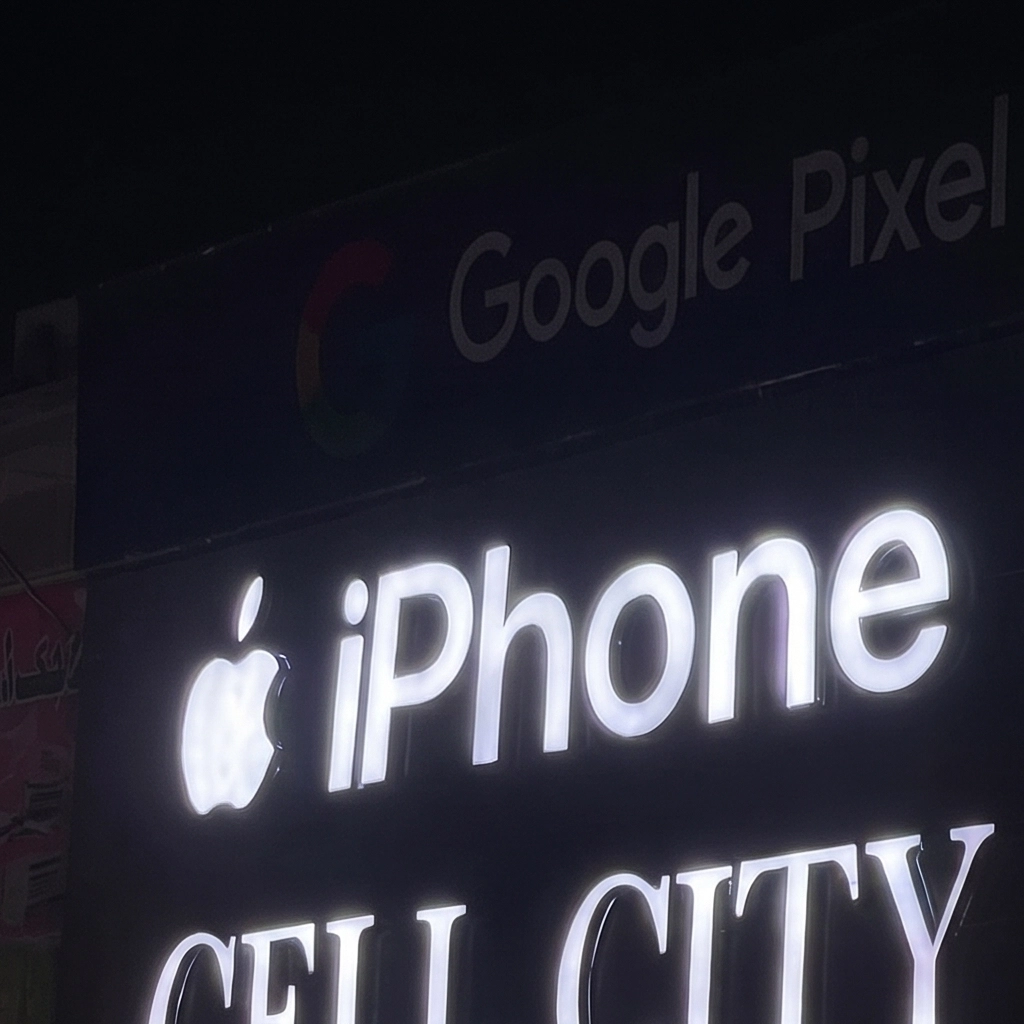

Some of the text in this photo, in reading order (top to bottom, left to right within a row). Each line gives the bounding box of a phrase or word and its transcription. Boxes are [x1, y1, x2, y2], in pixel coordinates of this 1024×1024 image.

[448, 92, 1009, 364] Google Pixel
[326, 506, 951, 794] iPhone
